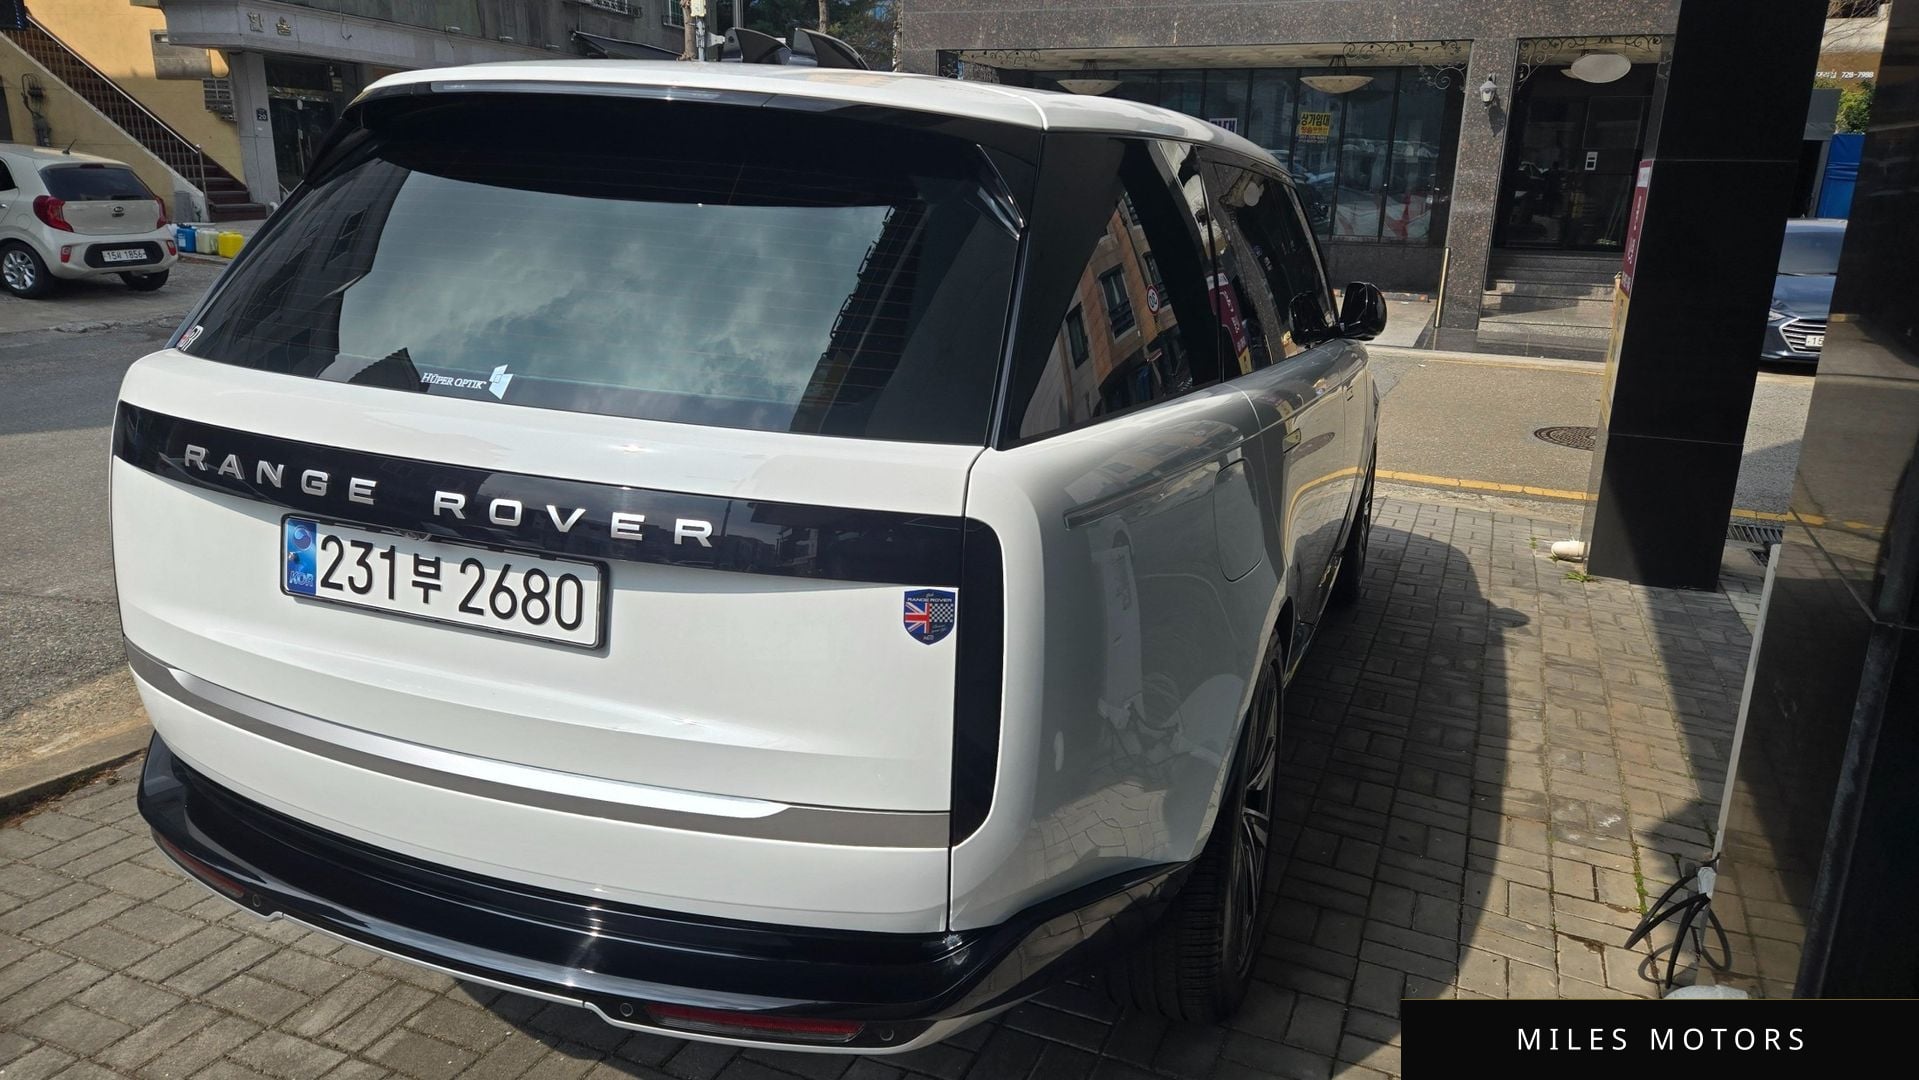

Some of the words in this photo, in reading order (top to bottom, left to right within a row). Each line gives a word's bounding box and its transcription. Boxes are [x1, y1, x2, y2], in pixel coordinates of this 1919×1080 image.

[1301, 113, 1330, 126] 상가임대
[183, 443, 378, 506] RANGE
[432, 490, 715, 549] ROVER
[320, 534, 442, 605] 231부
[458, 557, 583, 631] 2680
